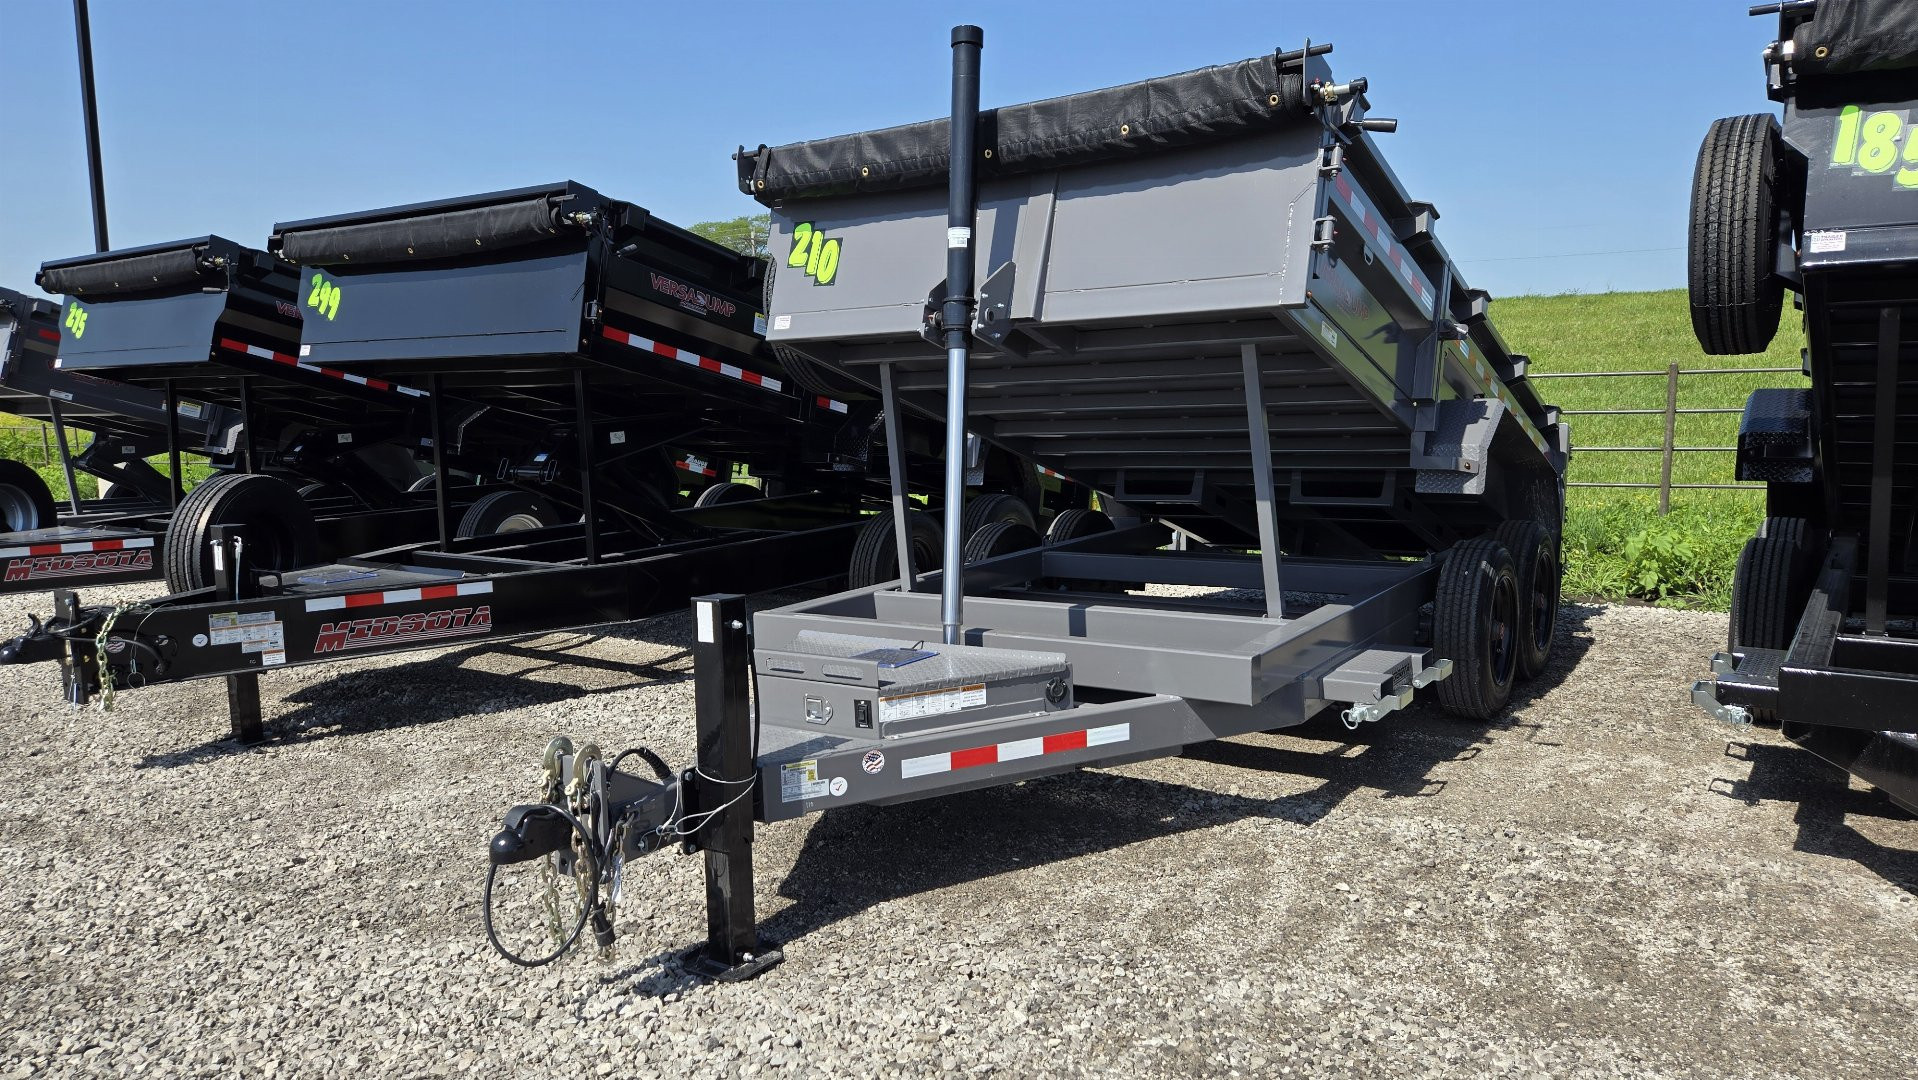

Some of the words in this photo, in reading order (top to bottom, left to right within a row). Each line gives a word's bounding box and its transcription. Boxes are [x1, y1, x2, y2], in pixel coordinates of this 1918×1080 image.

[788, 223, 840, 284] 210
[307, 273, 341, 321] 299
[650, 272, 736, 318] VERSADUMP
[4, 550, 153, 581] MIDSOTA
[314, 605, 492, 653] MIDSOTA
